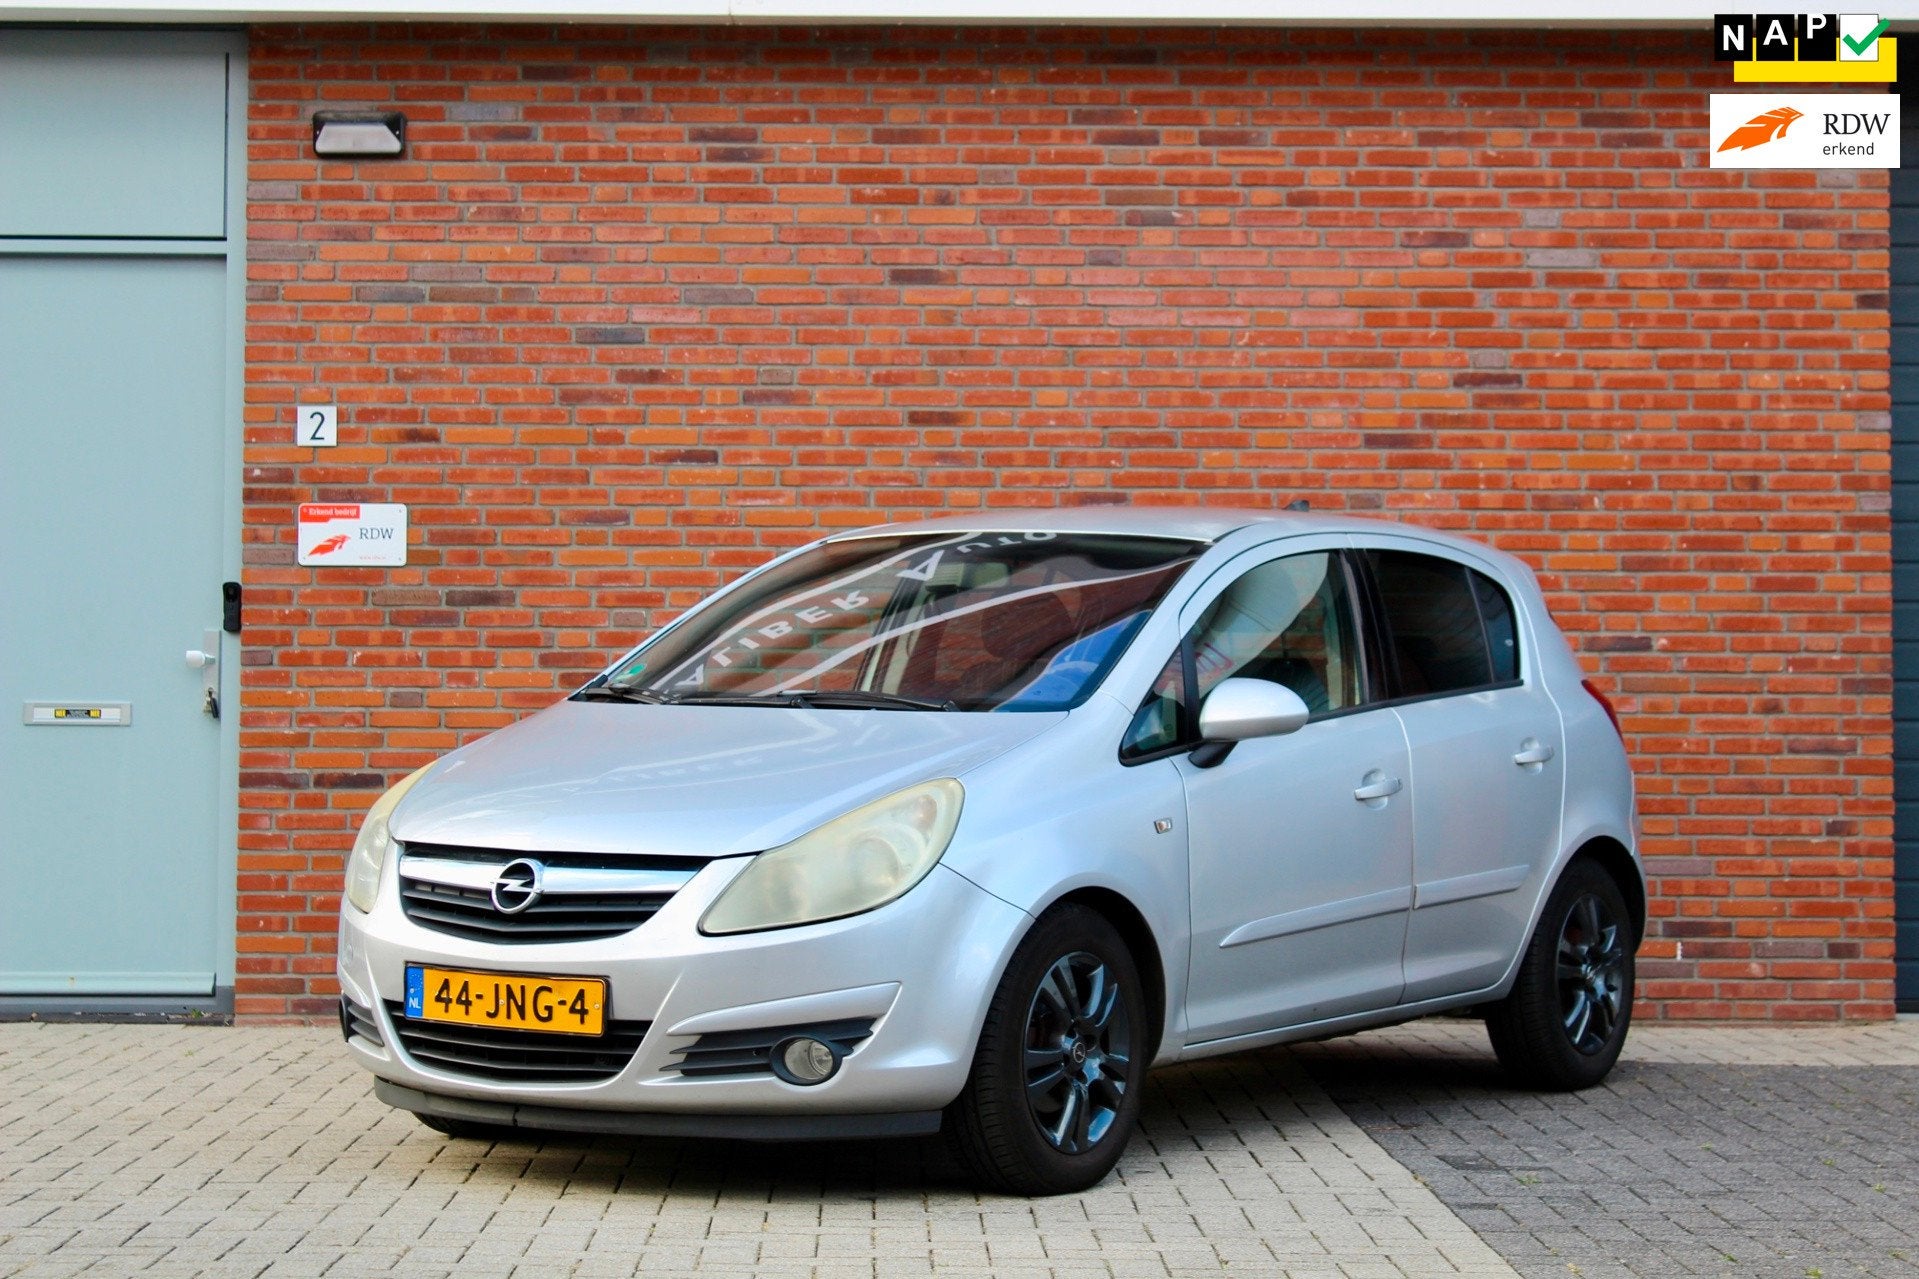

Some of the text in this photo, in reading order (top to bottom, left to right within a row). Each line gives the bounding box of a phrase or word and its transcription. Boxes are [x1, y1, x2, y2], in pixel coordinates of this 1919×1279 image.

[310, 411, 325, 441] 2
[308, 507, 334, 516] Erkend
[359, 527, 394, 540] RDW
[408, 998, 422, 1010] NL
[434, 978, 589, 1025] 44-JNG-4
